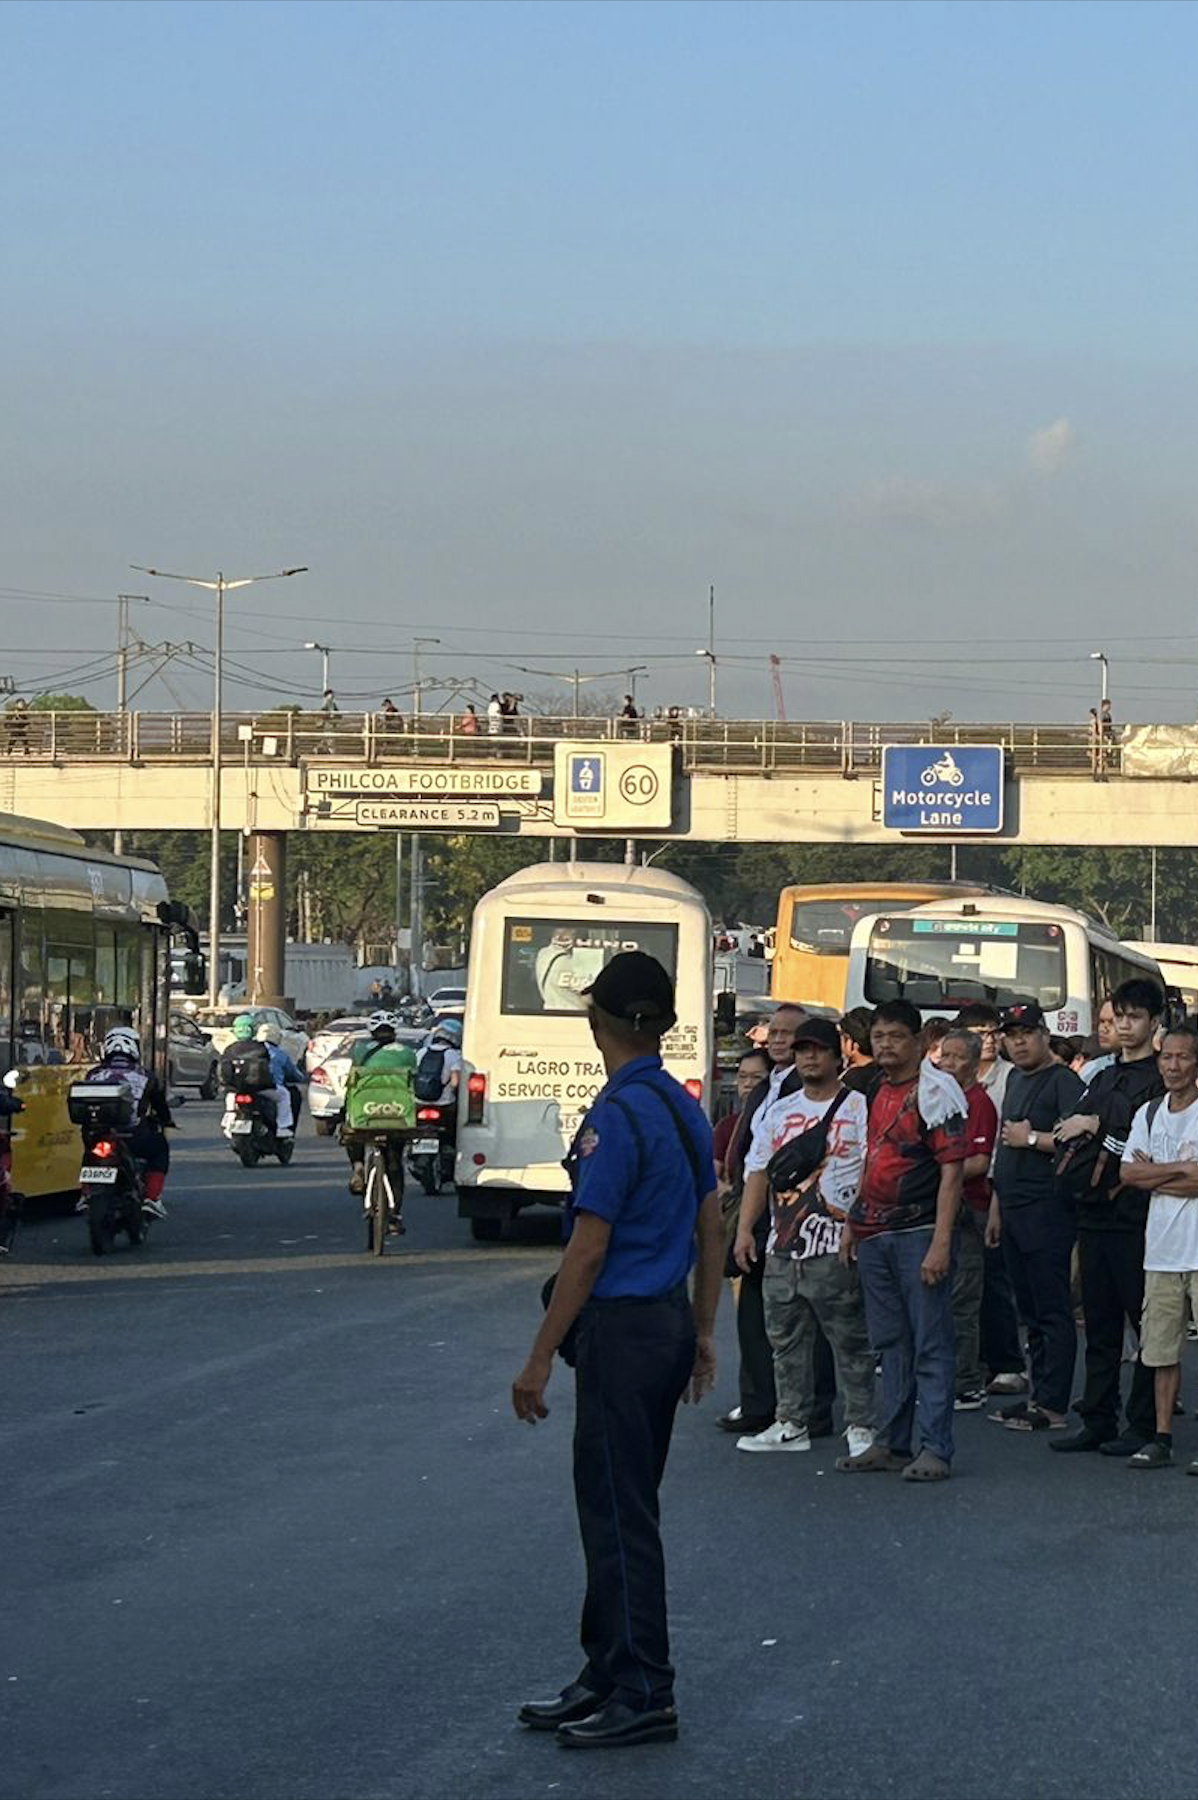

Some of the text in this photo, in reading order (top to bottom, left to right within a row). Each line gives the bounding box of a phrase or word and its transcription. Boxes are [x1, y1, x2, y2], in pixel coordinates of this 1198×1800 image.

[318, 773, 530, 790] PHILCOA FOOTBRIDGE
[625, 774, 653, 795] 60
[892, 789, 992, 809] Motorcycle
[361, 808, 448, 820] CLEARANCE
[457, 810, 479, 821] 5.2
[920, 810, 963, 825] Lane
[517, 1060, 604, 1076] LAGRO TRA
[498, 1082, 600, 1099] SERVICE COO
[363, 1101, 405, 1117] Grab
